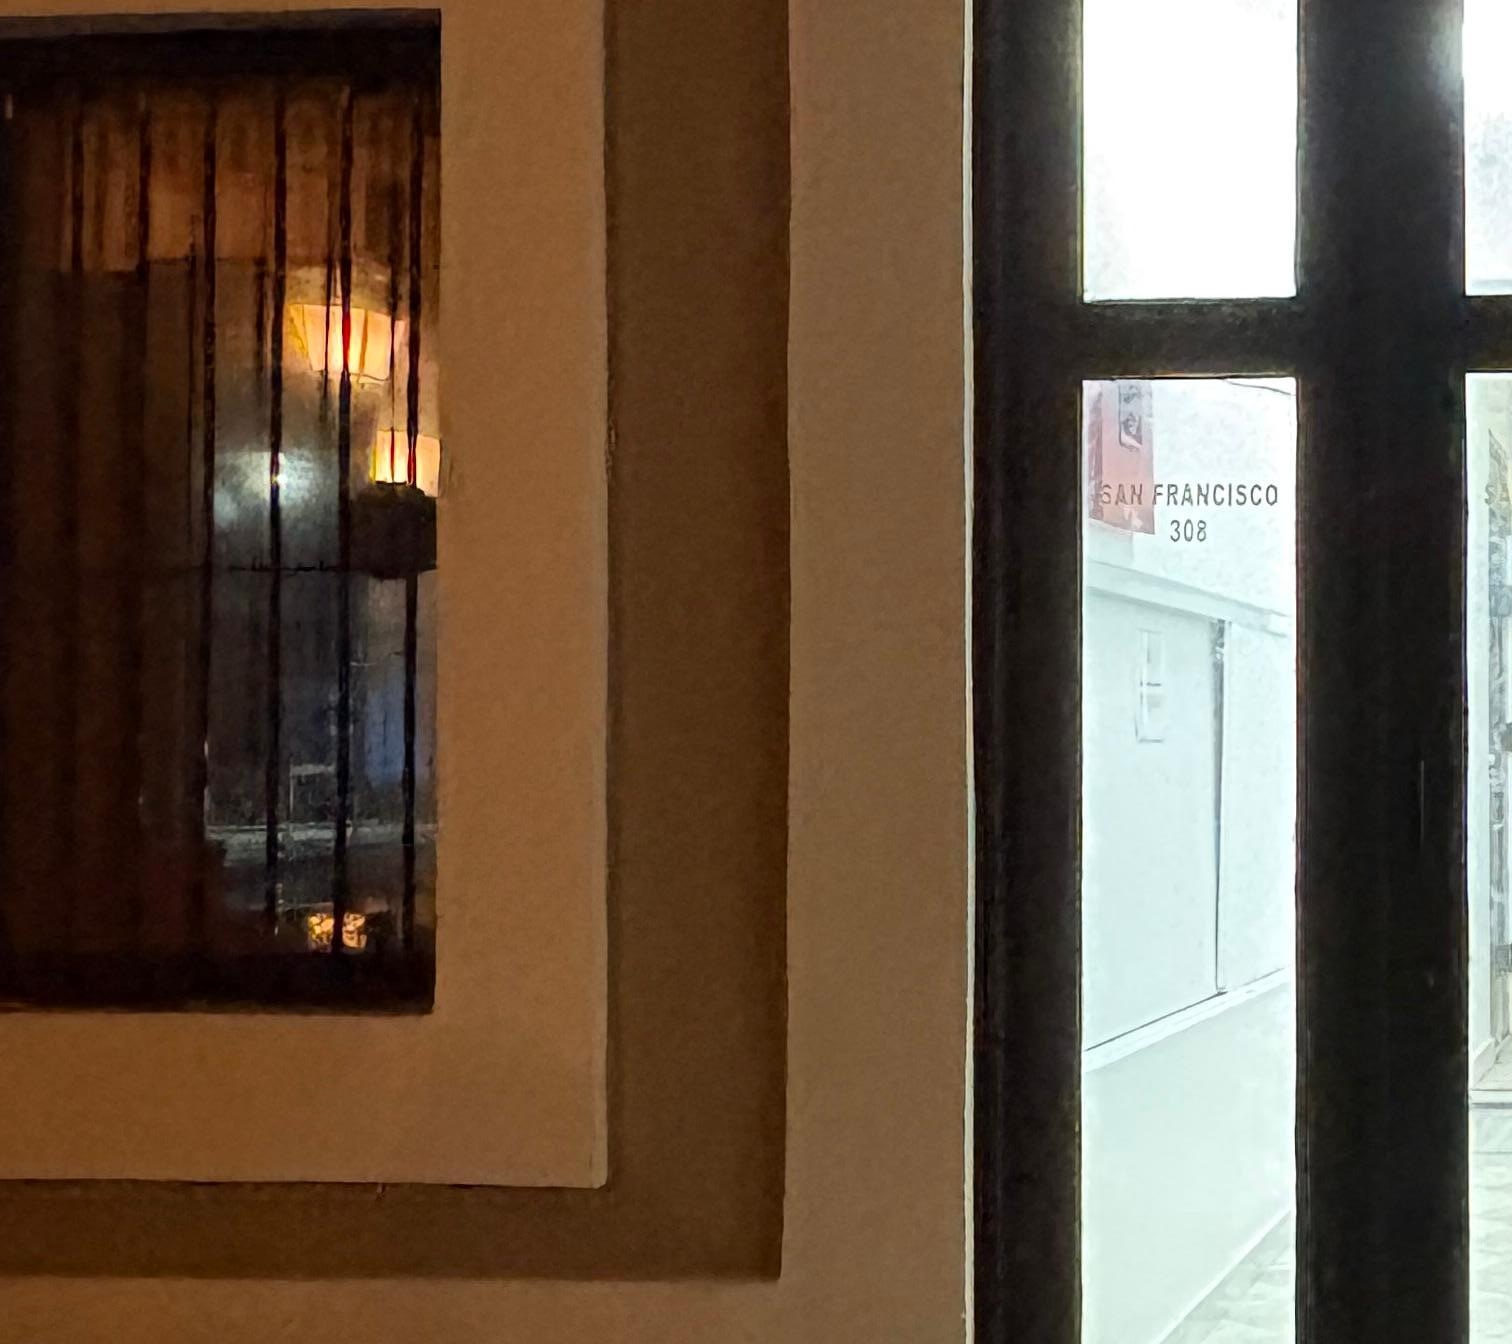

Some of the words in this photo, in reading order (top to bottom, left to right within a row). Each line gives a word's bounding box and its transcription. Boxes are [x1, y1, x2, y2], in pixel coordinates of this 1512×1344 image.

[1101, 483, 1143, 505] SAN
[1152, 483, 1279, 507] FRANCISCO
[1169, 519, 1207, 543] 308
